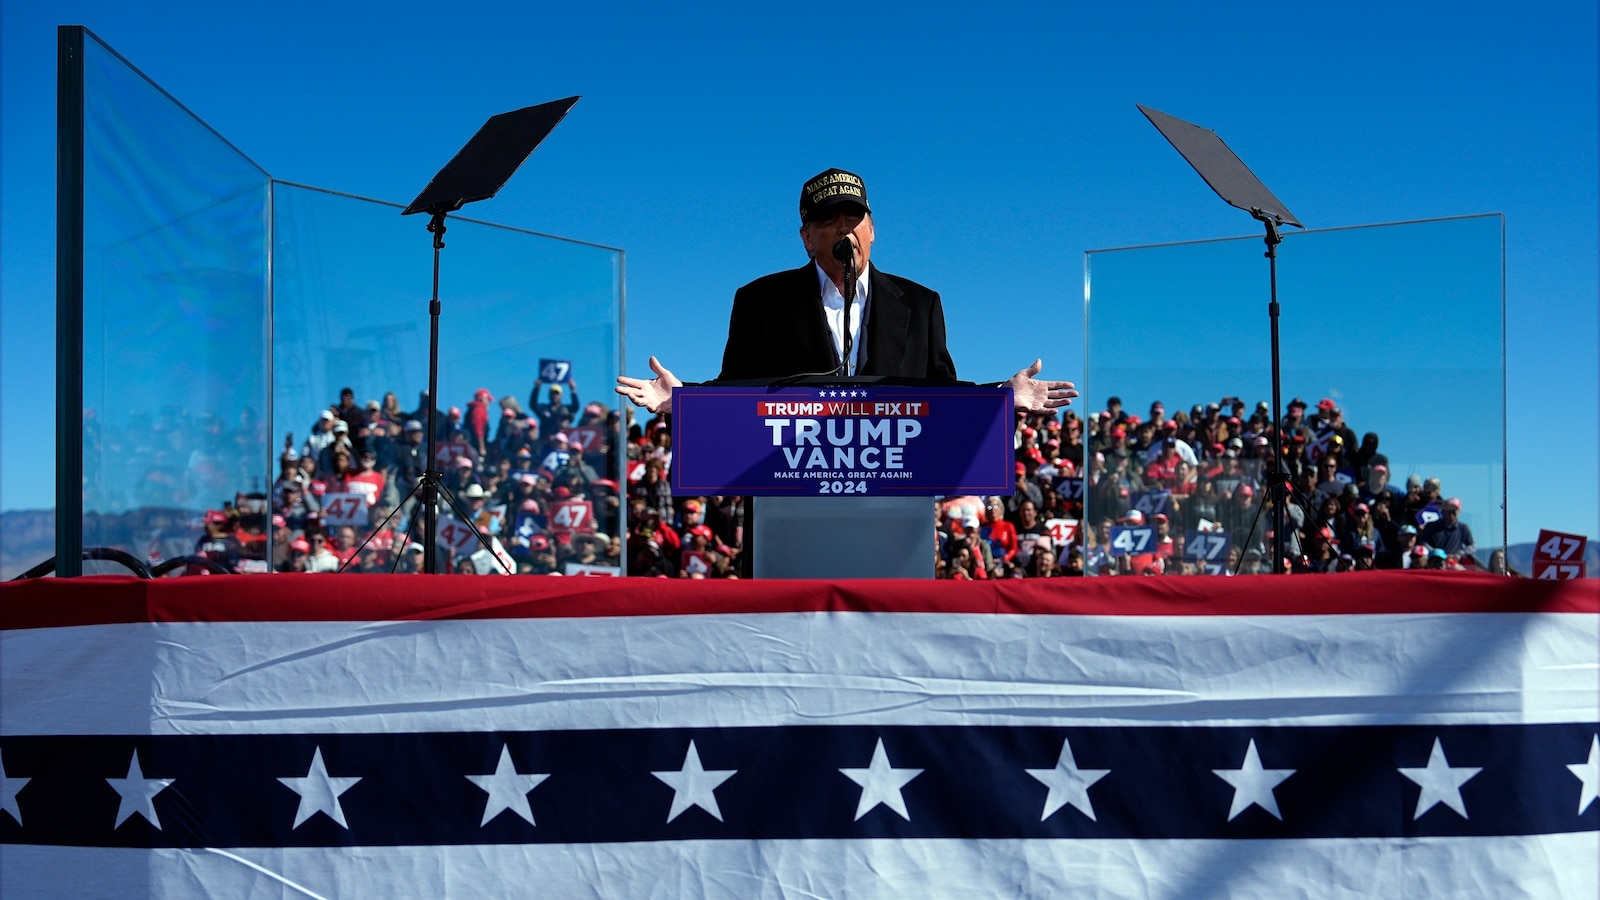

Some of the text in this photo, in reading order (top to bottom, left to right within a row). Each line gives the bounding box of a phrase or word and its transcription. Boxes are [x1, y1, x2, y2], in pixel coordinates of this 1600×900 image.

[806, 173, 862, 195] MAKE AMERICA
[813, 185, 862, 204] GREAT AGAIN
[541, 362, 570, 381] 47
[765, 402, 922, 416] TRUMP WILL FIX IT
[764, 418, 922, 446] TRUMP
[782, 447, 904, 470] VANCE
[774, 471, 913, 479] MAKE AMERICA GREAT AGAIN!
[819, 480, 868, 494] 2024
[1056, 480, 1083, 498] 47
[322, 498, 362, 519] 47
[1135, 493, 1168, 514] 47
[553, 505, 587, 527] 47
[440, 523, 474, 548] 47
[1050, 523, 1077, 541] 47
[1113, 529, 1152, 551] 47
[1186, 535, 1226, 560] 47
[1540, 536, 1581, 561] 47
[1537, 565, 1579, 580] 47
